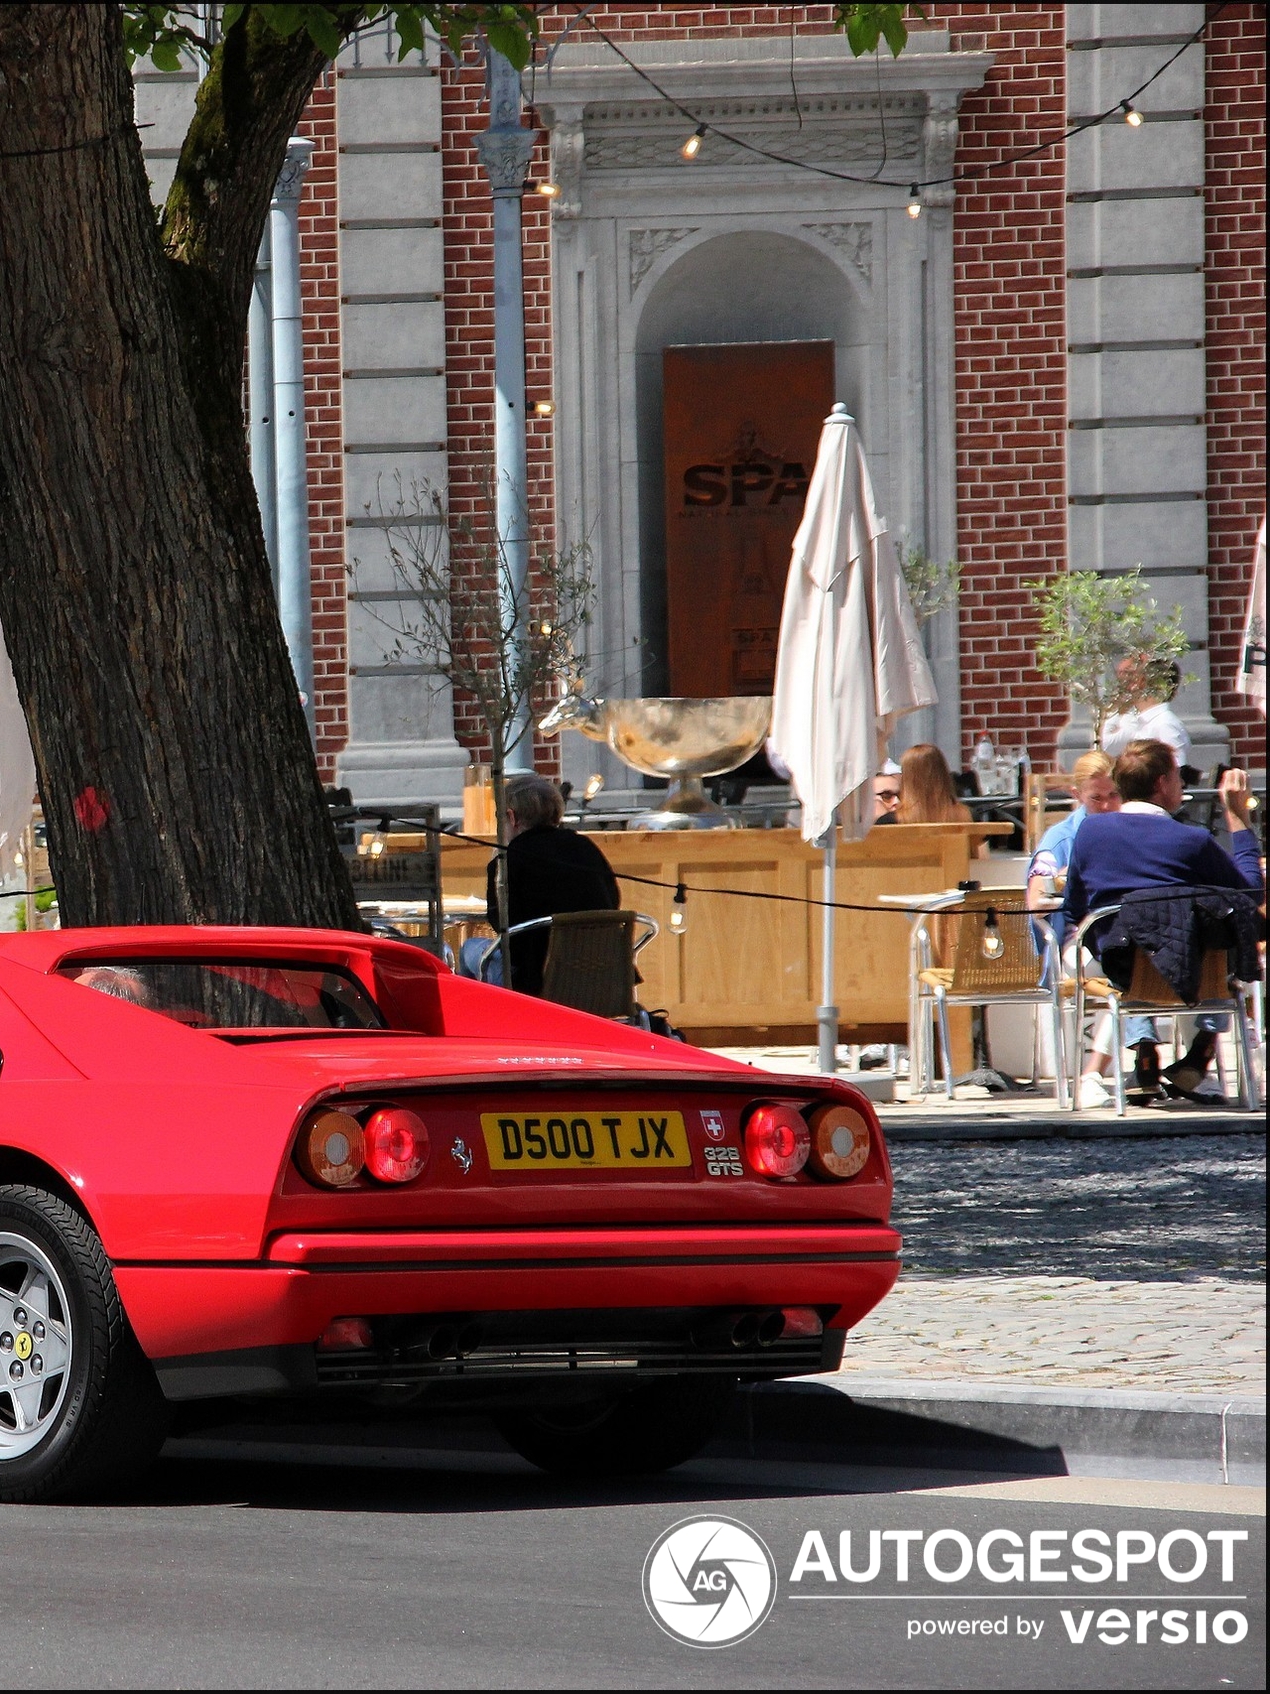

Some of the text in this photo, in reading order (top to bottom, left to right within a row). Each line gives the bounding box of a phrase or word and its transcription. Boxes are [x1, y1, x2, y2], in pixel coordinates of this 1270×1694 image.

[498, 1118, 594, 1159] D500
[704, 1147, 740, 1160] 328
[707, 1162, 743, 1176] GTS
